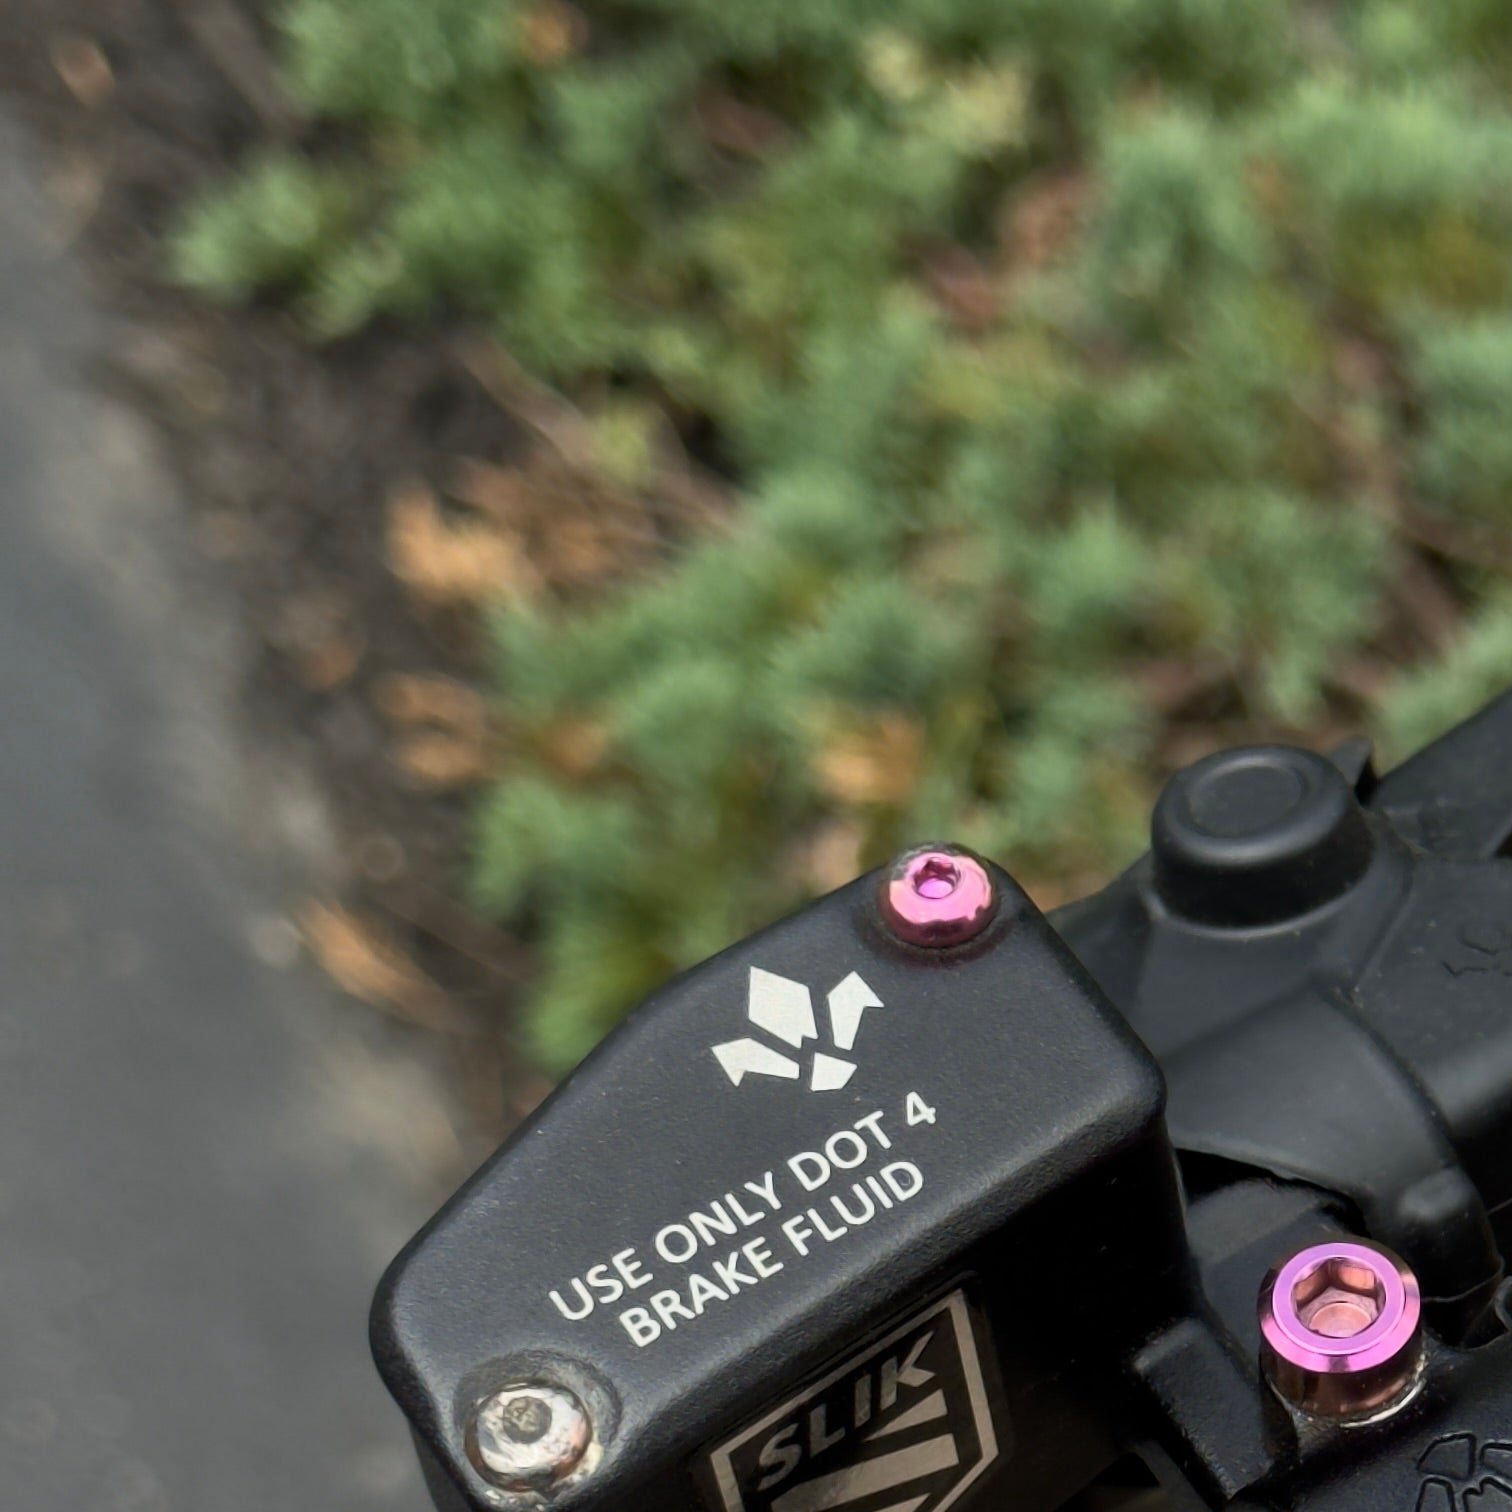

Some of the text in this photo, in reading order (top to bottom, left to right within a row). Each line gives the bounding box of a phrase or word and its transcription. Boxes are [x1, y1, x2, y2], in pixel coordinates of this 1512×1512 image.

[548, 1090, 937, 1321] USE ONLY DOT 4
[618, 1160, 925, 1348] BRAKE FLUID
[756, 1330, 936, 1491] SLIK
